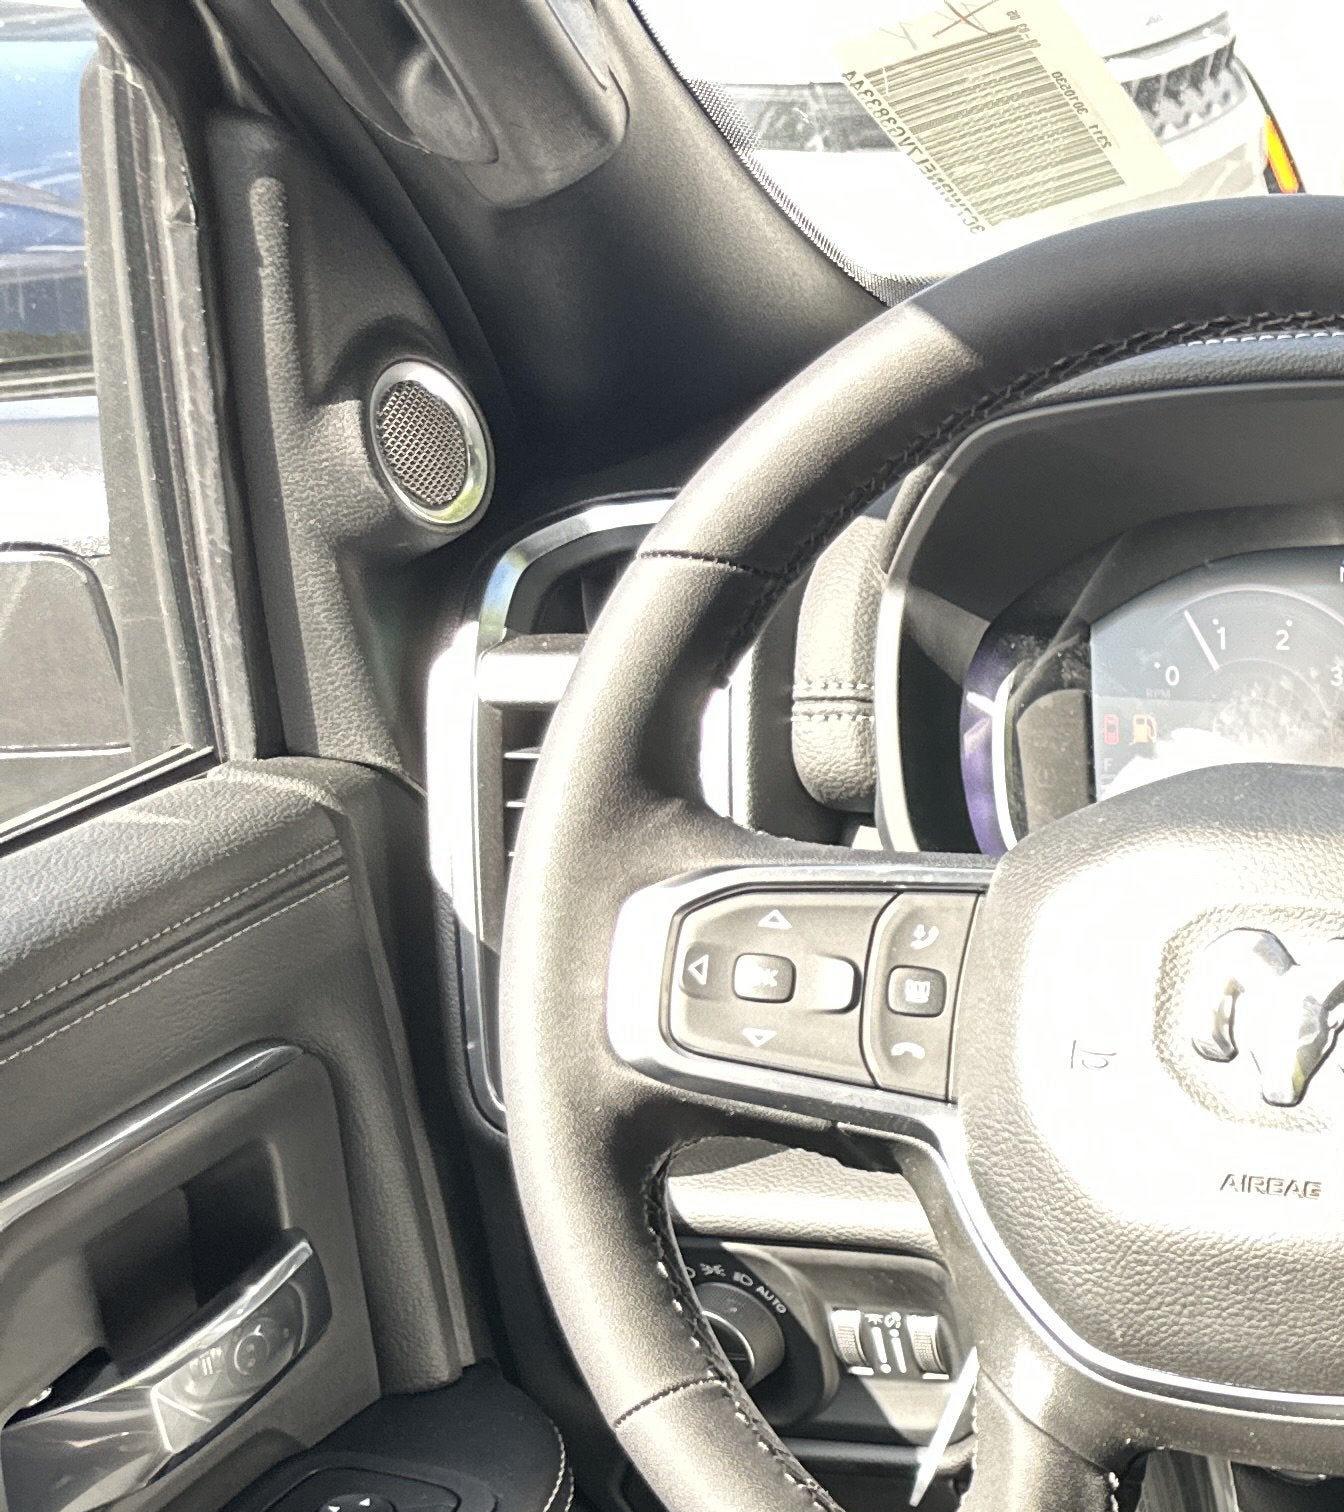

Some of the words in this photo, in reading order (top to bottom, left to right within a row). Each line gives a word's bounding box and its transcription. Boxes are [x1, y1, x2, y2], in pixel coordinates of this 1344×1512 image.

[1216, 626, 1227, 651] 1
[1275, 629, 1291, 651] 2
[1165, 666, 1180, 687] 0
[1330, 666, 1344, 687] 3
[1219, 1173, 1322, 1200] AIRBAG
[755, 1285, 787, 1315] AUTO
